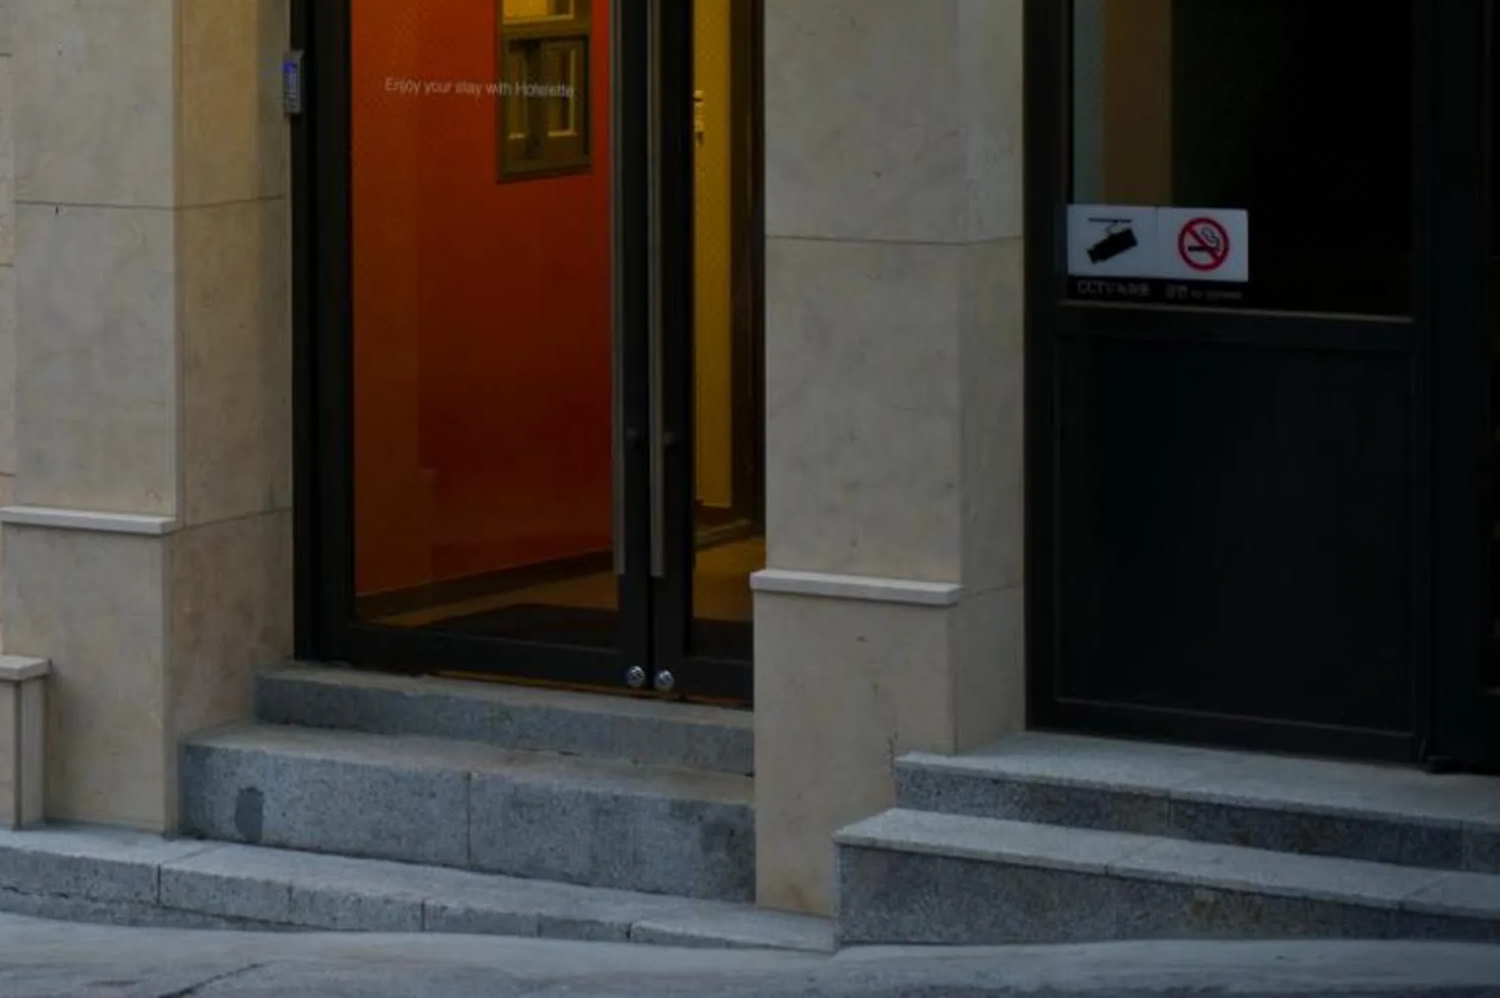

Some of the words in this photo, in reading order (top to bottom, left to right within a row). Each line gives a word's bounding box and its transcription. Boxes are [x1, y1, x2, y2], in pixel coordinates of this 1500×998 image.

[384, 77, 421, 96] Enjoy
[424, 81, 452, 96] your
[486, 80, 511, 95] with
